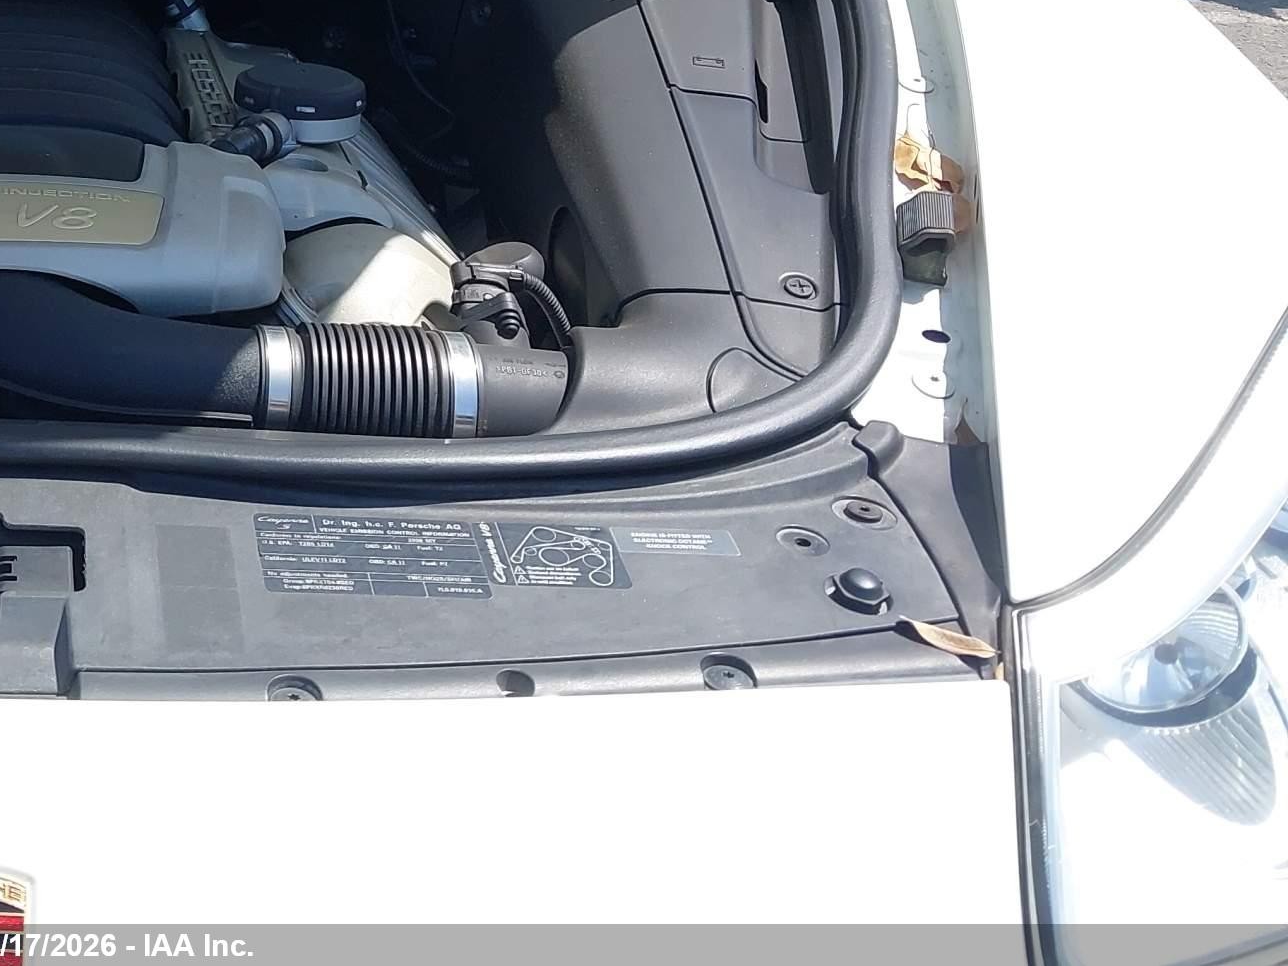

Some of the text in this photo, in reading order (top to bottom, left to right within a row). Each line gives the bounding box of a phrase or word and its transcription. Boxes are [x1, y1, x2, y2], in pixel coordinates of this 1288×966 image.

[3, 187, 130, 203] INJECTION
[16, 203, 99, 230] V8
[342, 519, 360, 528] Ing.
[400, 522, 441, 530] Porsche
